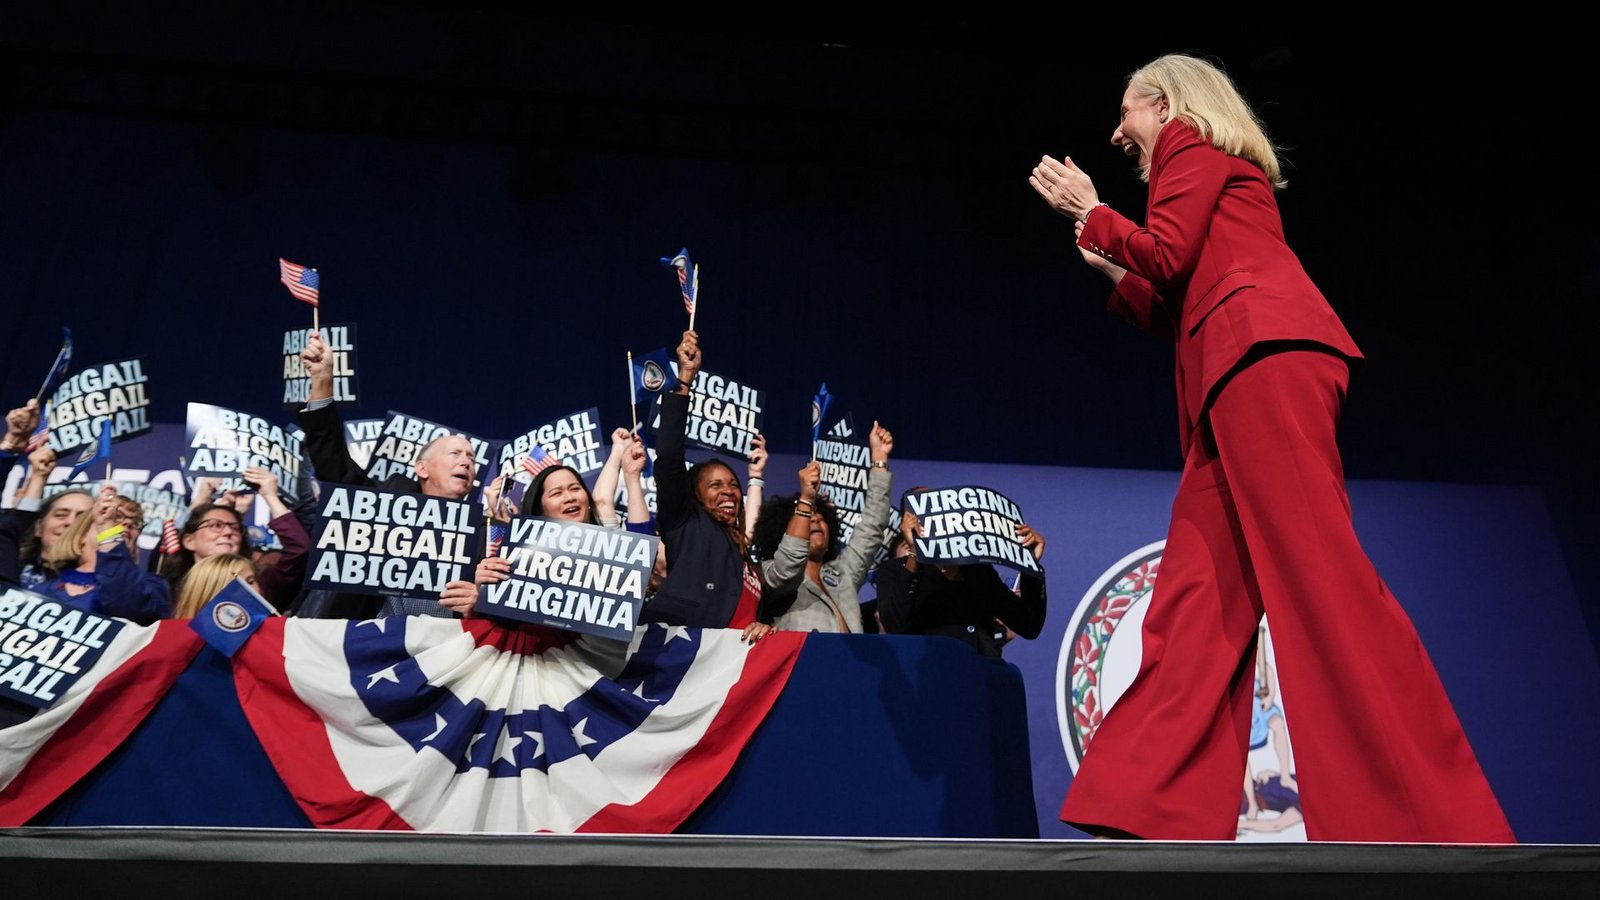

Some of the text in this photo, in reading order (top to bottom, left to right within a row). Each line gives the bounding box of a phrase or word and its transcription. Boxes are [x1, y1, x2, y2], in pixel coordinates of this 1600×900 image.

[499, 411, 597, 465] ABIGAIL
[322, 487, 475, 534] ABIGAIL
[907, 487, 1024, 525] VIRGINIA
[316, 519, 471, 564] ABIGAIL
[509, 518, 650, 568] VIRGINIA
[916, 534, 1038, 572] VIRGINIA
[0, 588, 112, 649] BIGAIL
[487, 578, 633, 631] VIRGINIA
